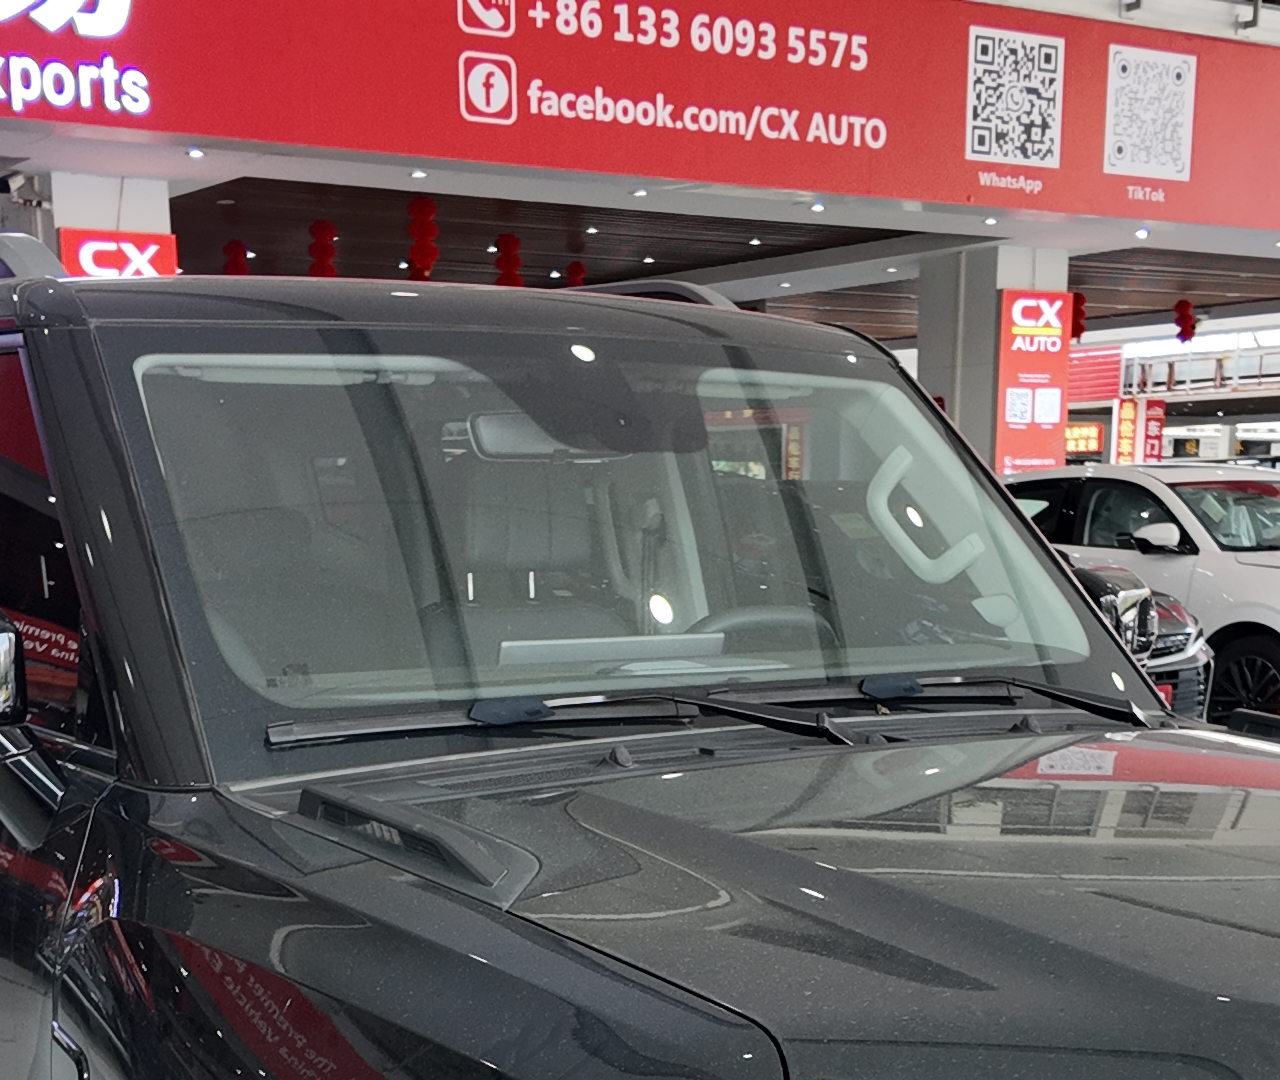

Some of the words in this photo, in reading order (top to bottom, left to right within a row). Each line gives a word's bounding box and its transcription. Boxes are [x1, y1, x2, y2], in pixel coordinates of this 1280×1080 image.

[528, 0, 601, 40] +86
[613, 3, 680, 50] 133
[690, 14, 777, 60] 6093
[787, 26, 869, 73] 5575
[527, 79, 800, 143] facebook.com/CX
[807, 112, 887, 149] AUTO
[978, 171, 1043, 194] WhatsApp
[1127, 185, 1165, 203] TikTok
[78, 241, 160, 277] CX
[1011, 298, 1064, 328] CX
[1011, 335, 1062, 353] AUTO
